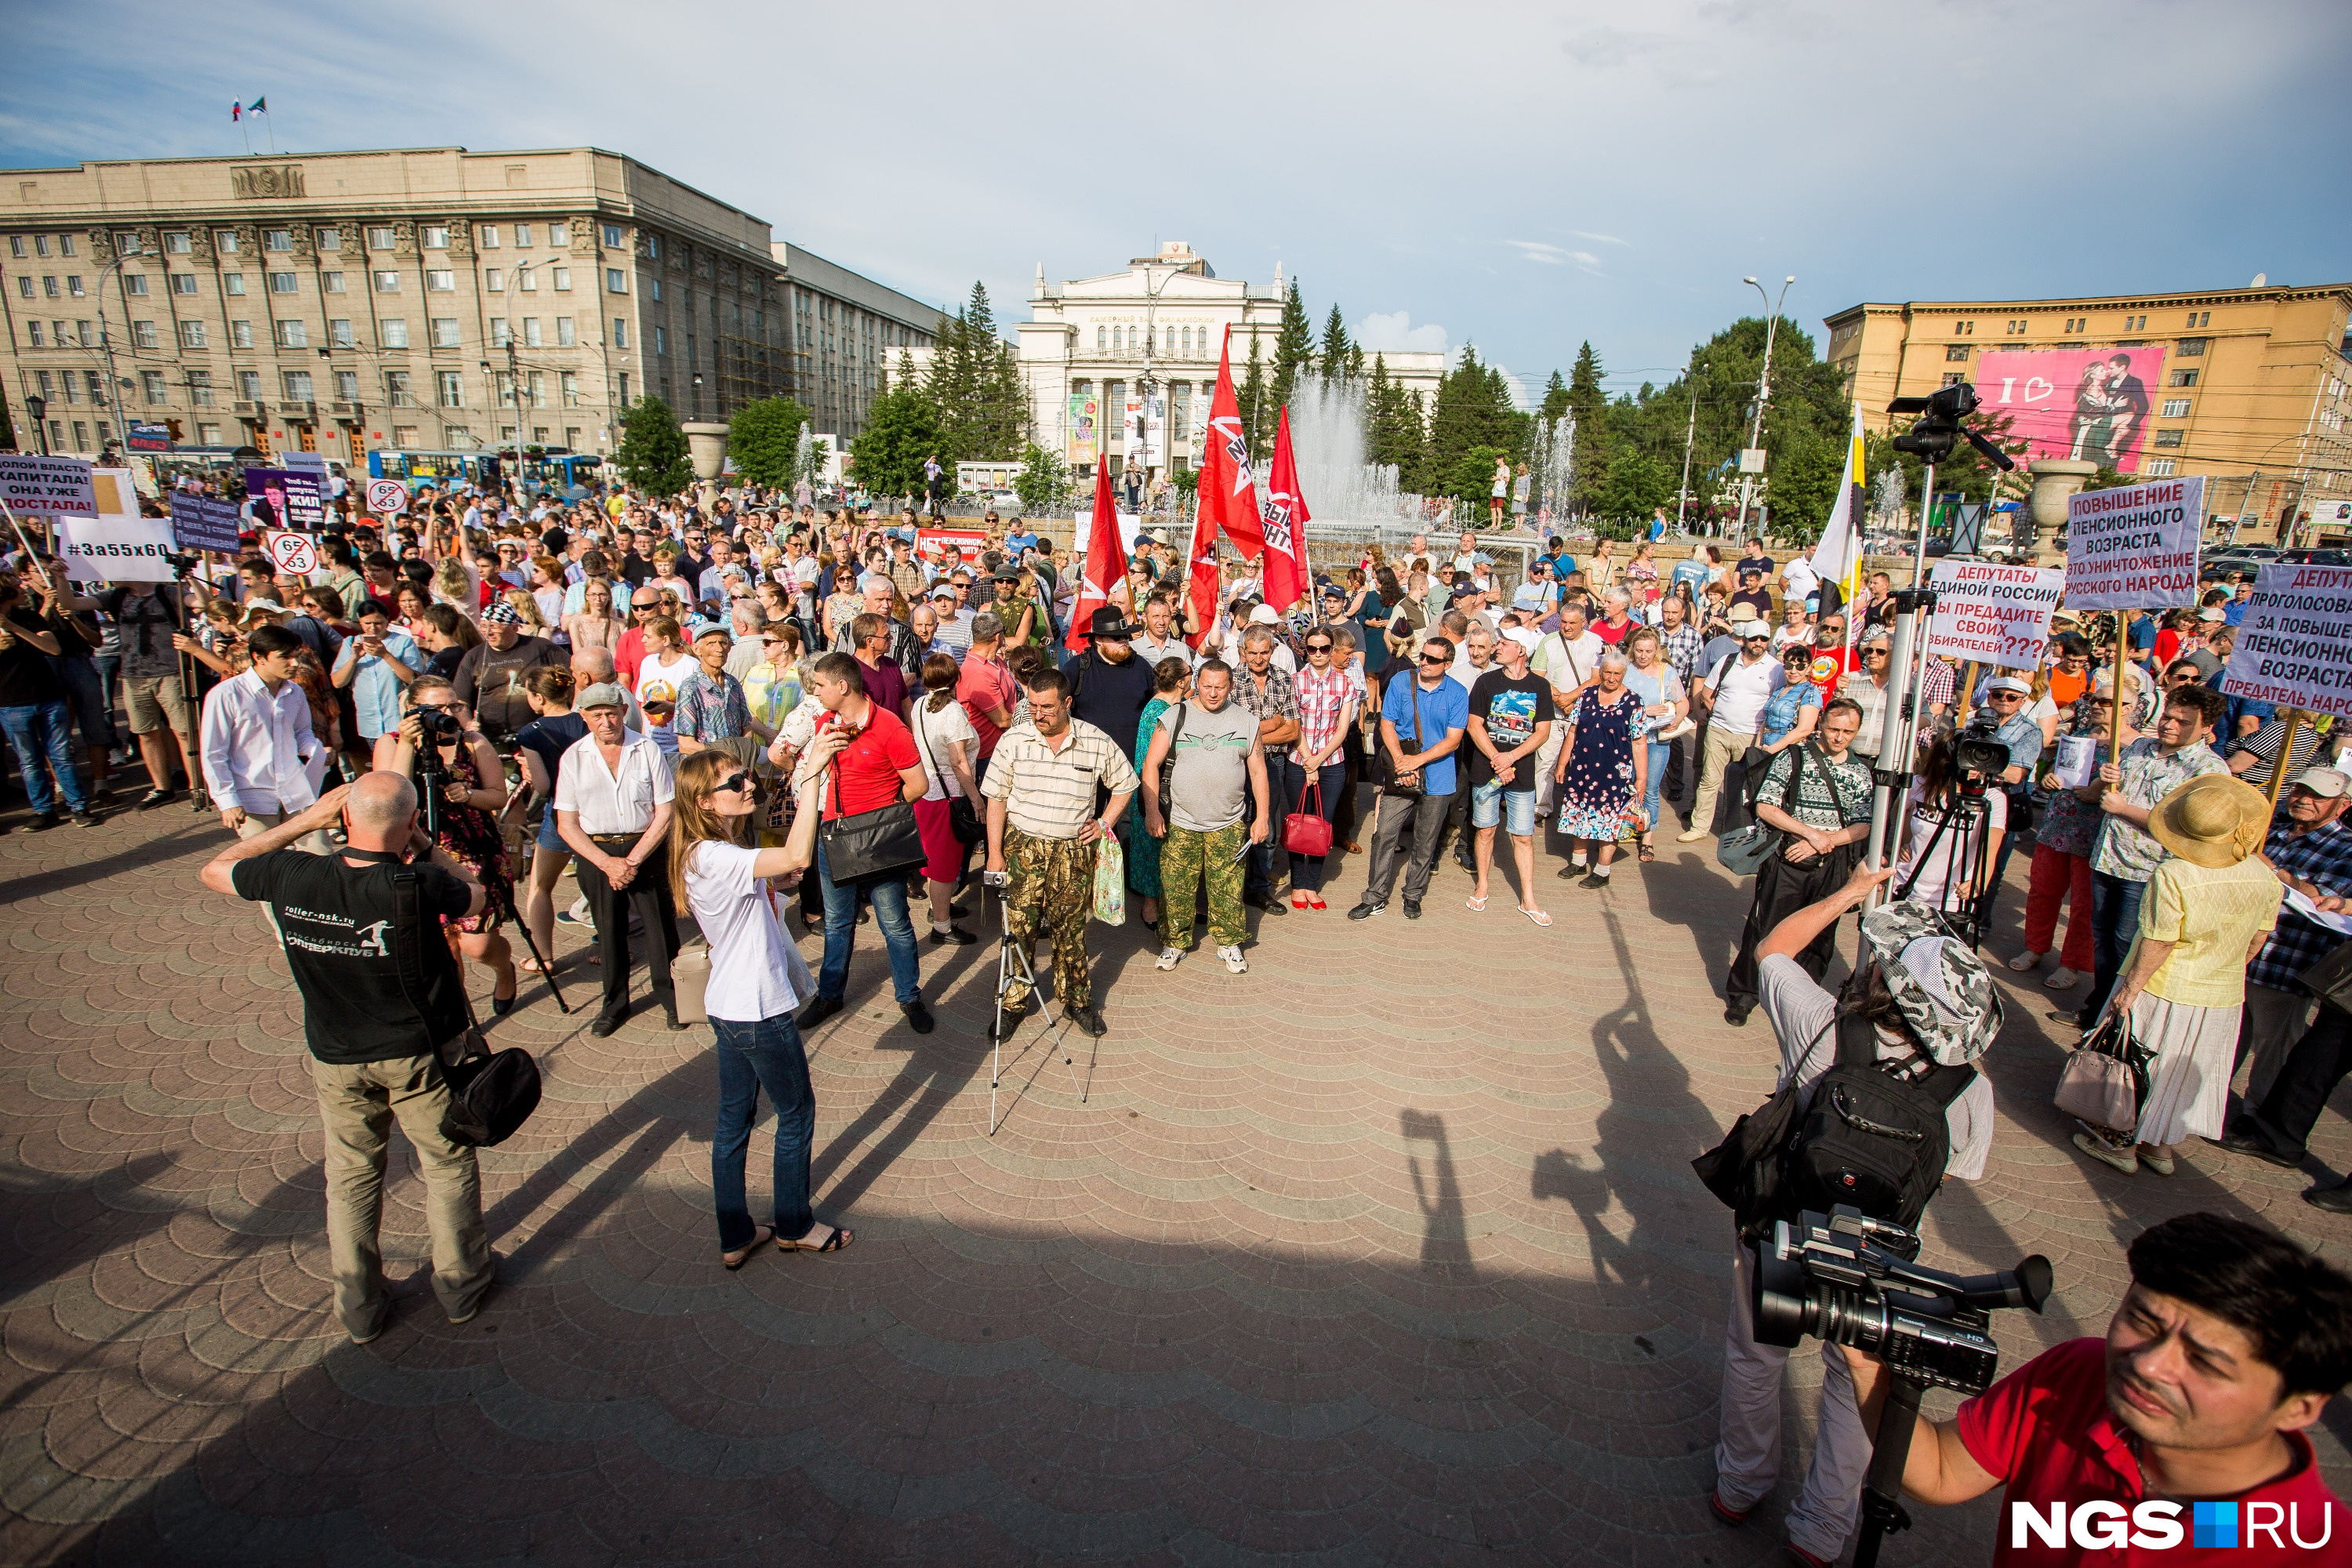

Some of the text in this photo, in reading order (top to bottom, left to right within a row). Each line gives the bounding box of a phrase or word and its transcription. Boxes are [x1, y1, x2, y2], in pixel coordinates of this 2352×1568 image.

[1998, 377, 2016, 403] I
[0, 461, 87, 473] ОЛОЙ ВЛАСТЬ
[0, 471, 89, 485] КАПИТАЛА!
[8, 485, 80, 497] ОНА УЖЕ
[287, 495, 321, 507] ЖИЛ
[2074, 483, 2184, 517] ПОВЫШЕНИЕ
[0, 498, 92, 511] ДОСТАЛА!
[2073, 506, 2184, 536] ПЕНСИОННОГО
[2085, 532, 2161, 555] ВОЗРАСТА
[1956, 566, 2038, 583] ДЕПУТАТЫ
[2067, 552, 2194, 576] ЭТО УНИЧТОЖЕНИЕ
[2064, 572, 2195, 595] РУССКОГО НАРОДА
[2290, 569, 2352, 590] ДЕПУТ
[1929, 580, 2059, 603] ЕДИНОЙ РОССИИ
[1936, 601, 2045, 624] Ы ПРЕДАДИТЕ
[1956, 619, 2009, 637] СВОИХ
[2256, 615, 2352, 640] ЗА ПОВЫШЕ
[2259, 659, 2352, 691] ВОЗРАСТА
[2223, 679, 2307, 707] ПРЕДАТЕЛЬ
[285, 906, 355, 925] roller-nsk.ru
[1897, 1316, 1926, 1327] Panasonic
[1966, 1333, 1984, 1343] HD
